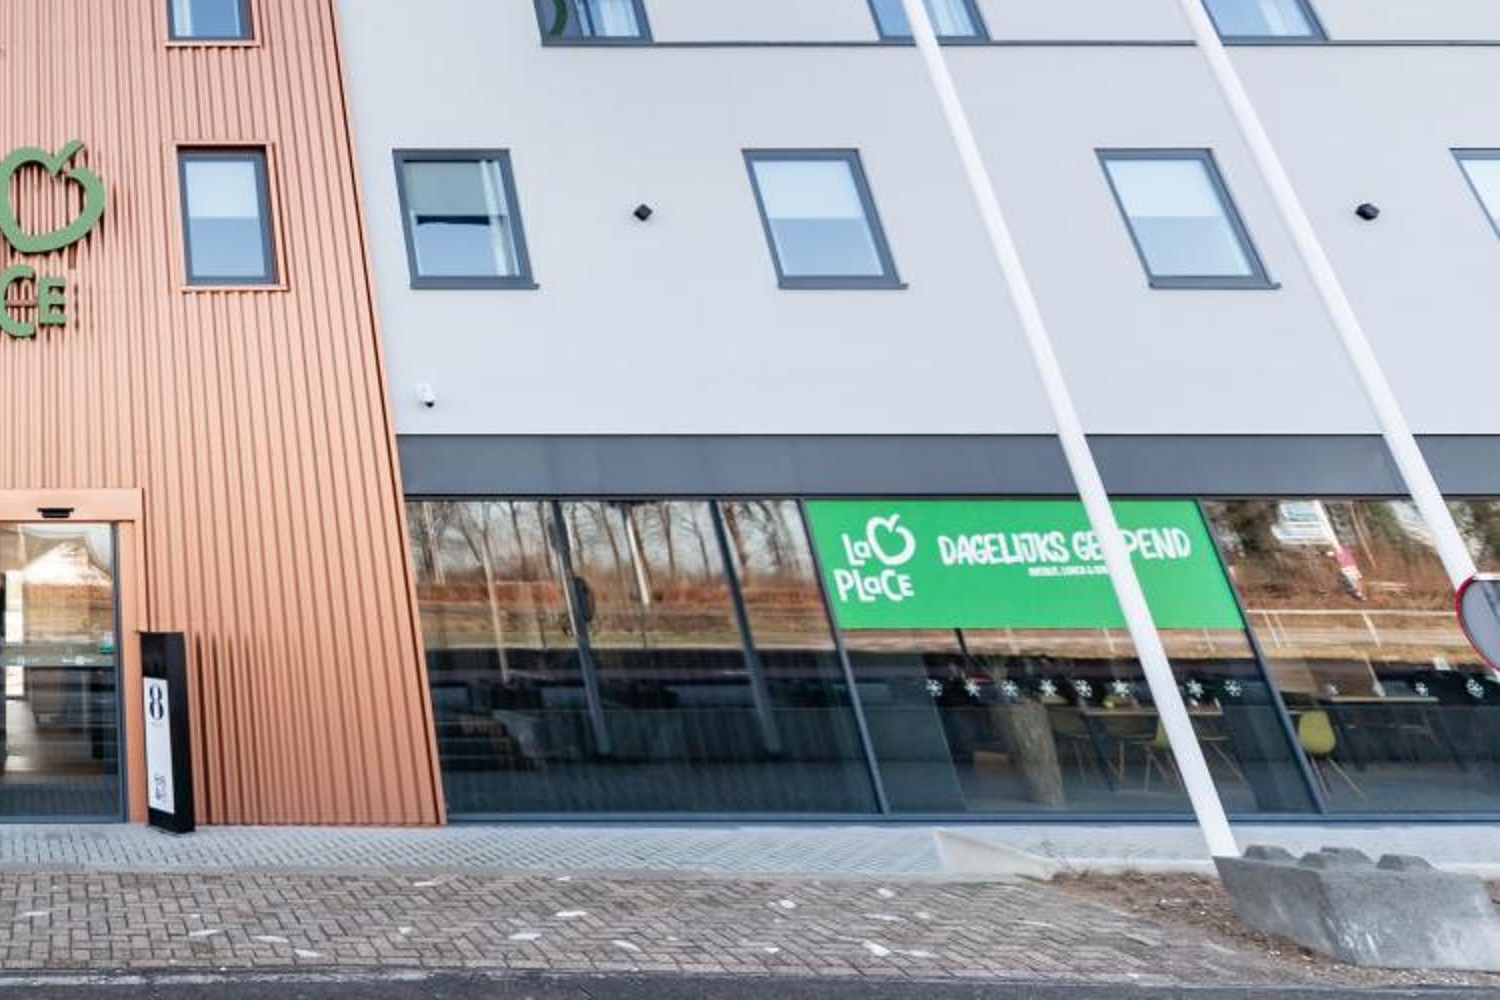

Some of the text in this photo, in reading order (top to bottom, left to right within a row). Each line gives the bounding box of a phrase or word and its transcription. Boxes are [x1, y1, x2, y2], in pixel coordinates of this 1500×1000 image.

[842, 533, 872, 567] La
[937, 527, 1191, 566] DAGELIJKS GEPEND
[833, 567, 915, 602] PLaCE
